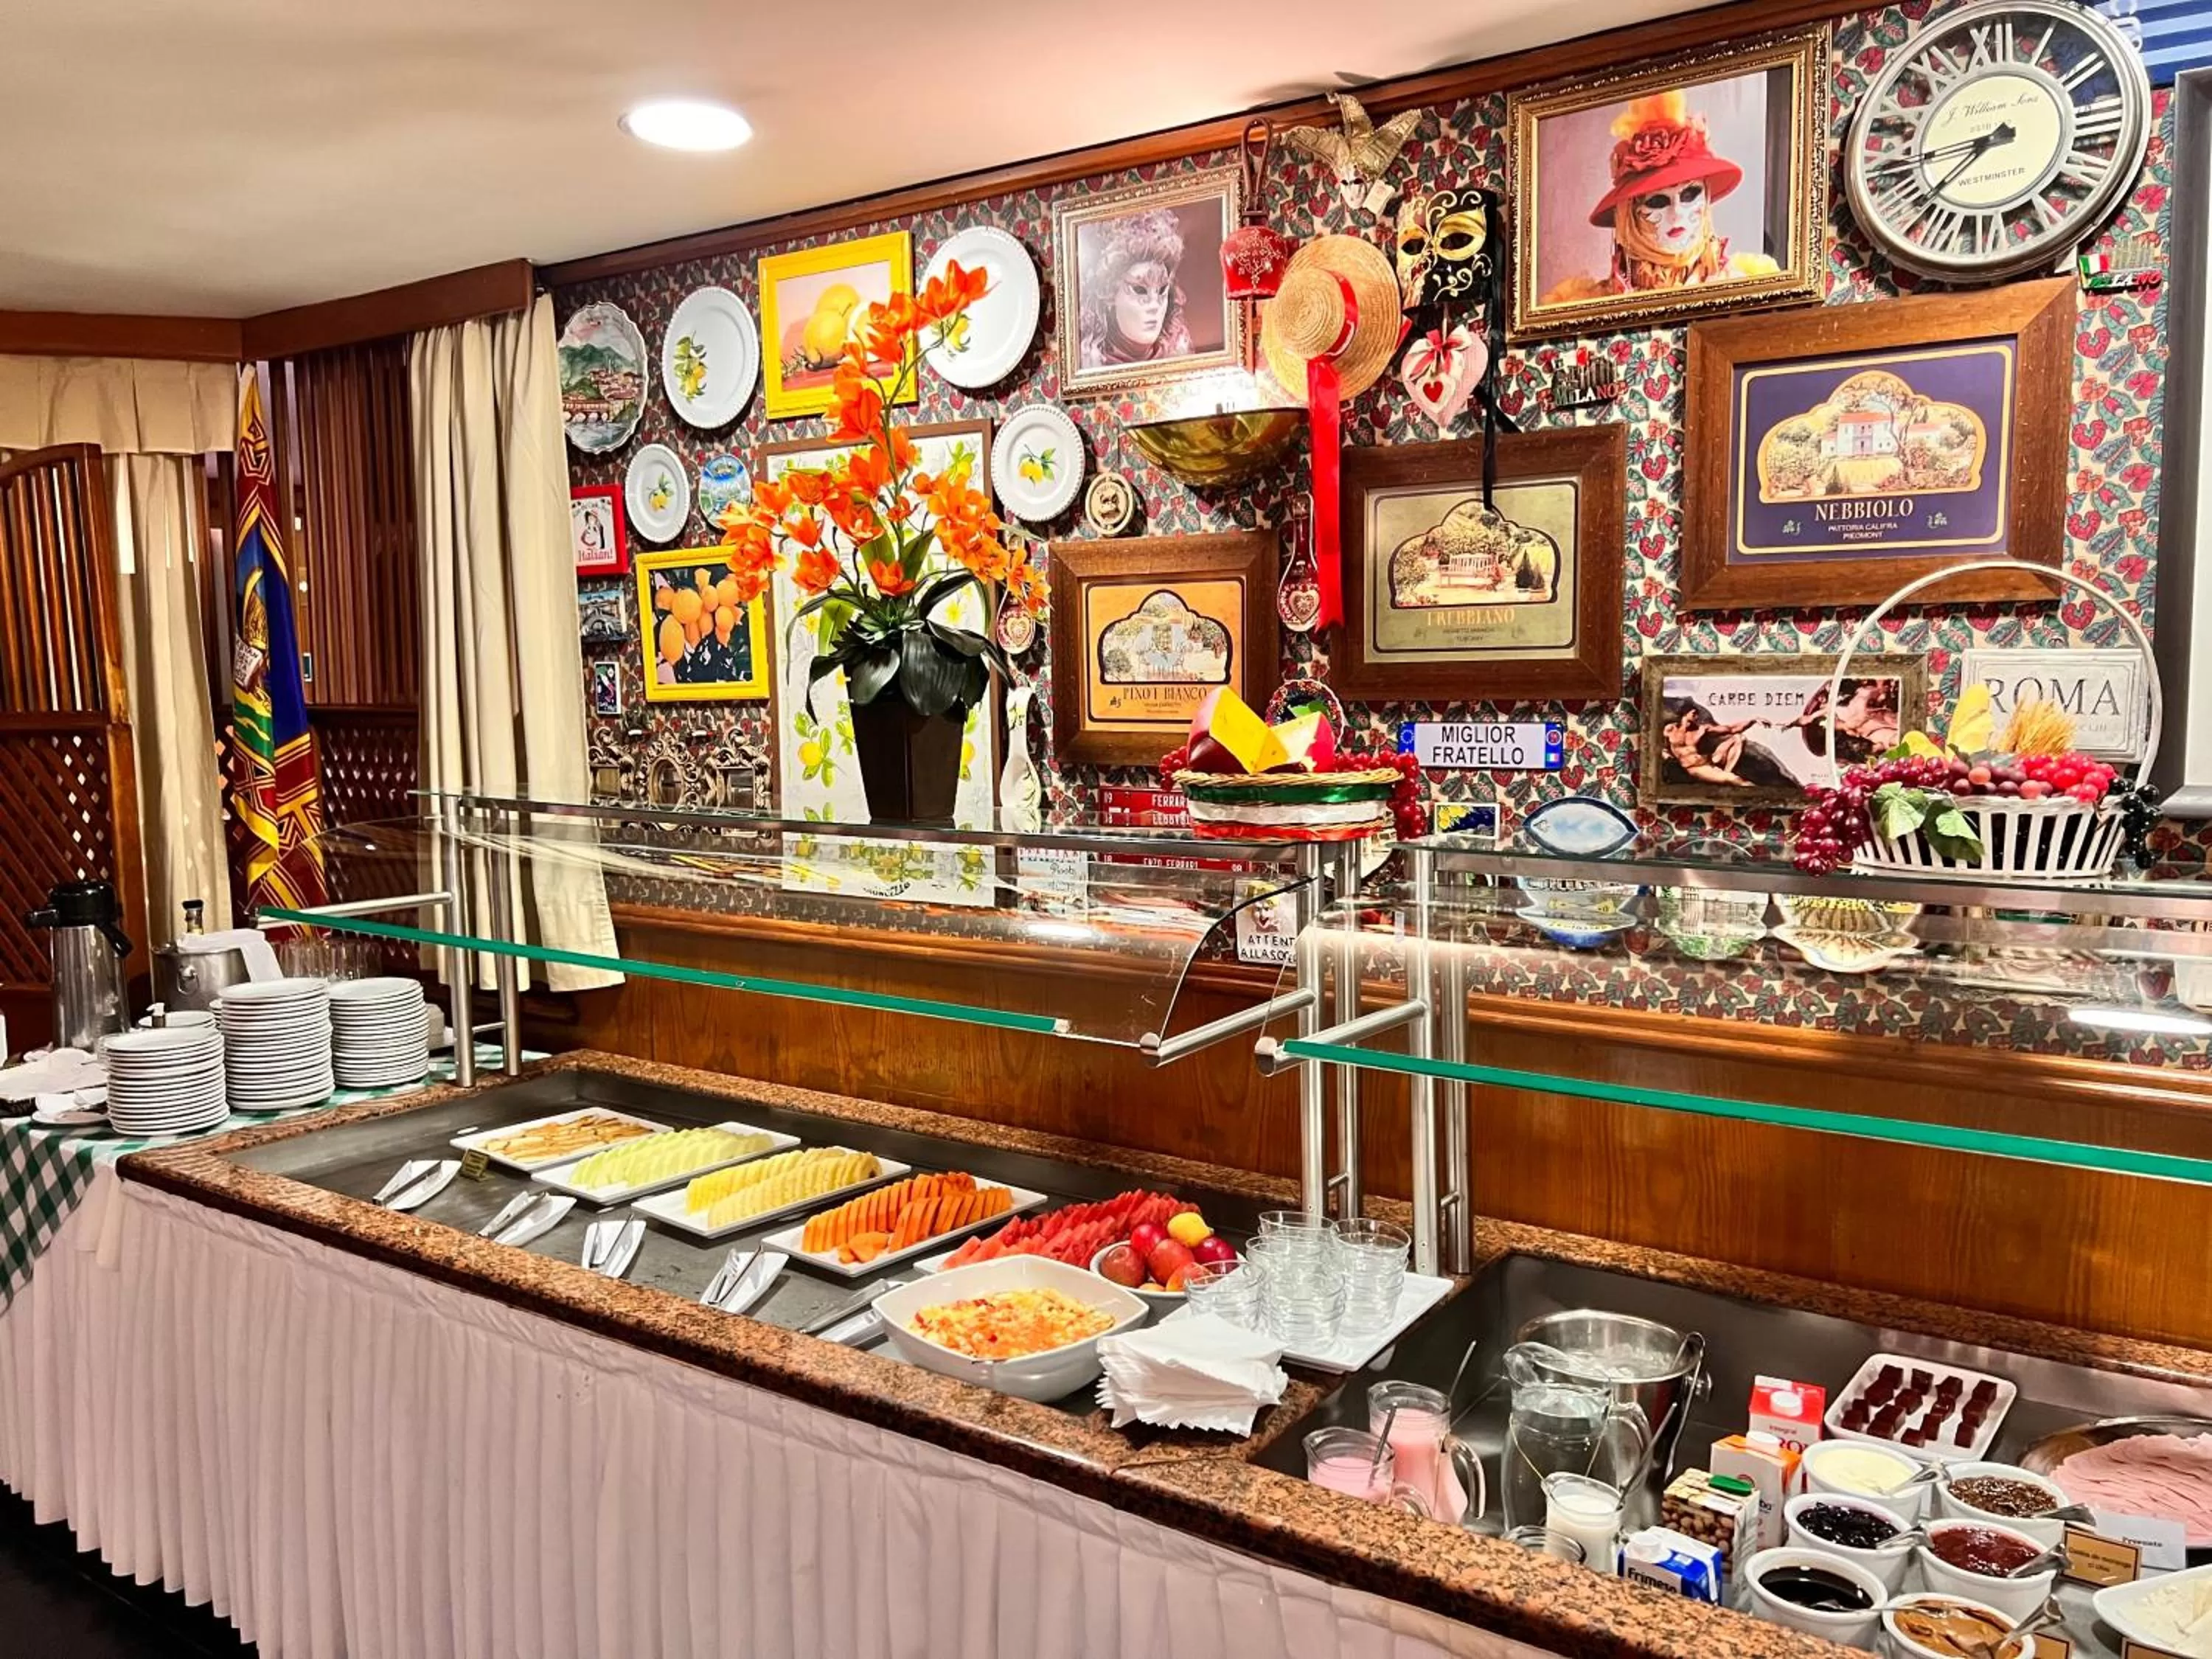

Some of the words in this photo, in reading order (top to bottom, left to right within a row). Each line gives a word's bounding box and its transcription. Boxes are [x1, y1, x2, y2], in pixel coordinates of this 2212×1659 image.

[1958, 167, 2025, 187] WESTMINSTER
[1554, 383, 1618, 406] MILANO
[1815, 498, 1914, 521] NEBBIOLO
[1123, 686, 1159, 700] PINOT
[1164, 686, 1208, 701] BIANCO
[1708, 692, 1756, 706] CARPE
[1765, 692, 1805, 706] DIEM
[1983, 677, 2121, 716] ROMA
[1441, 726, 1516, 744] MIGLIOR
[1433, 746, 1524, 765] FRATELLO
[1248, 934, 1295, 947] ATTENT
